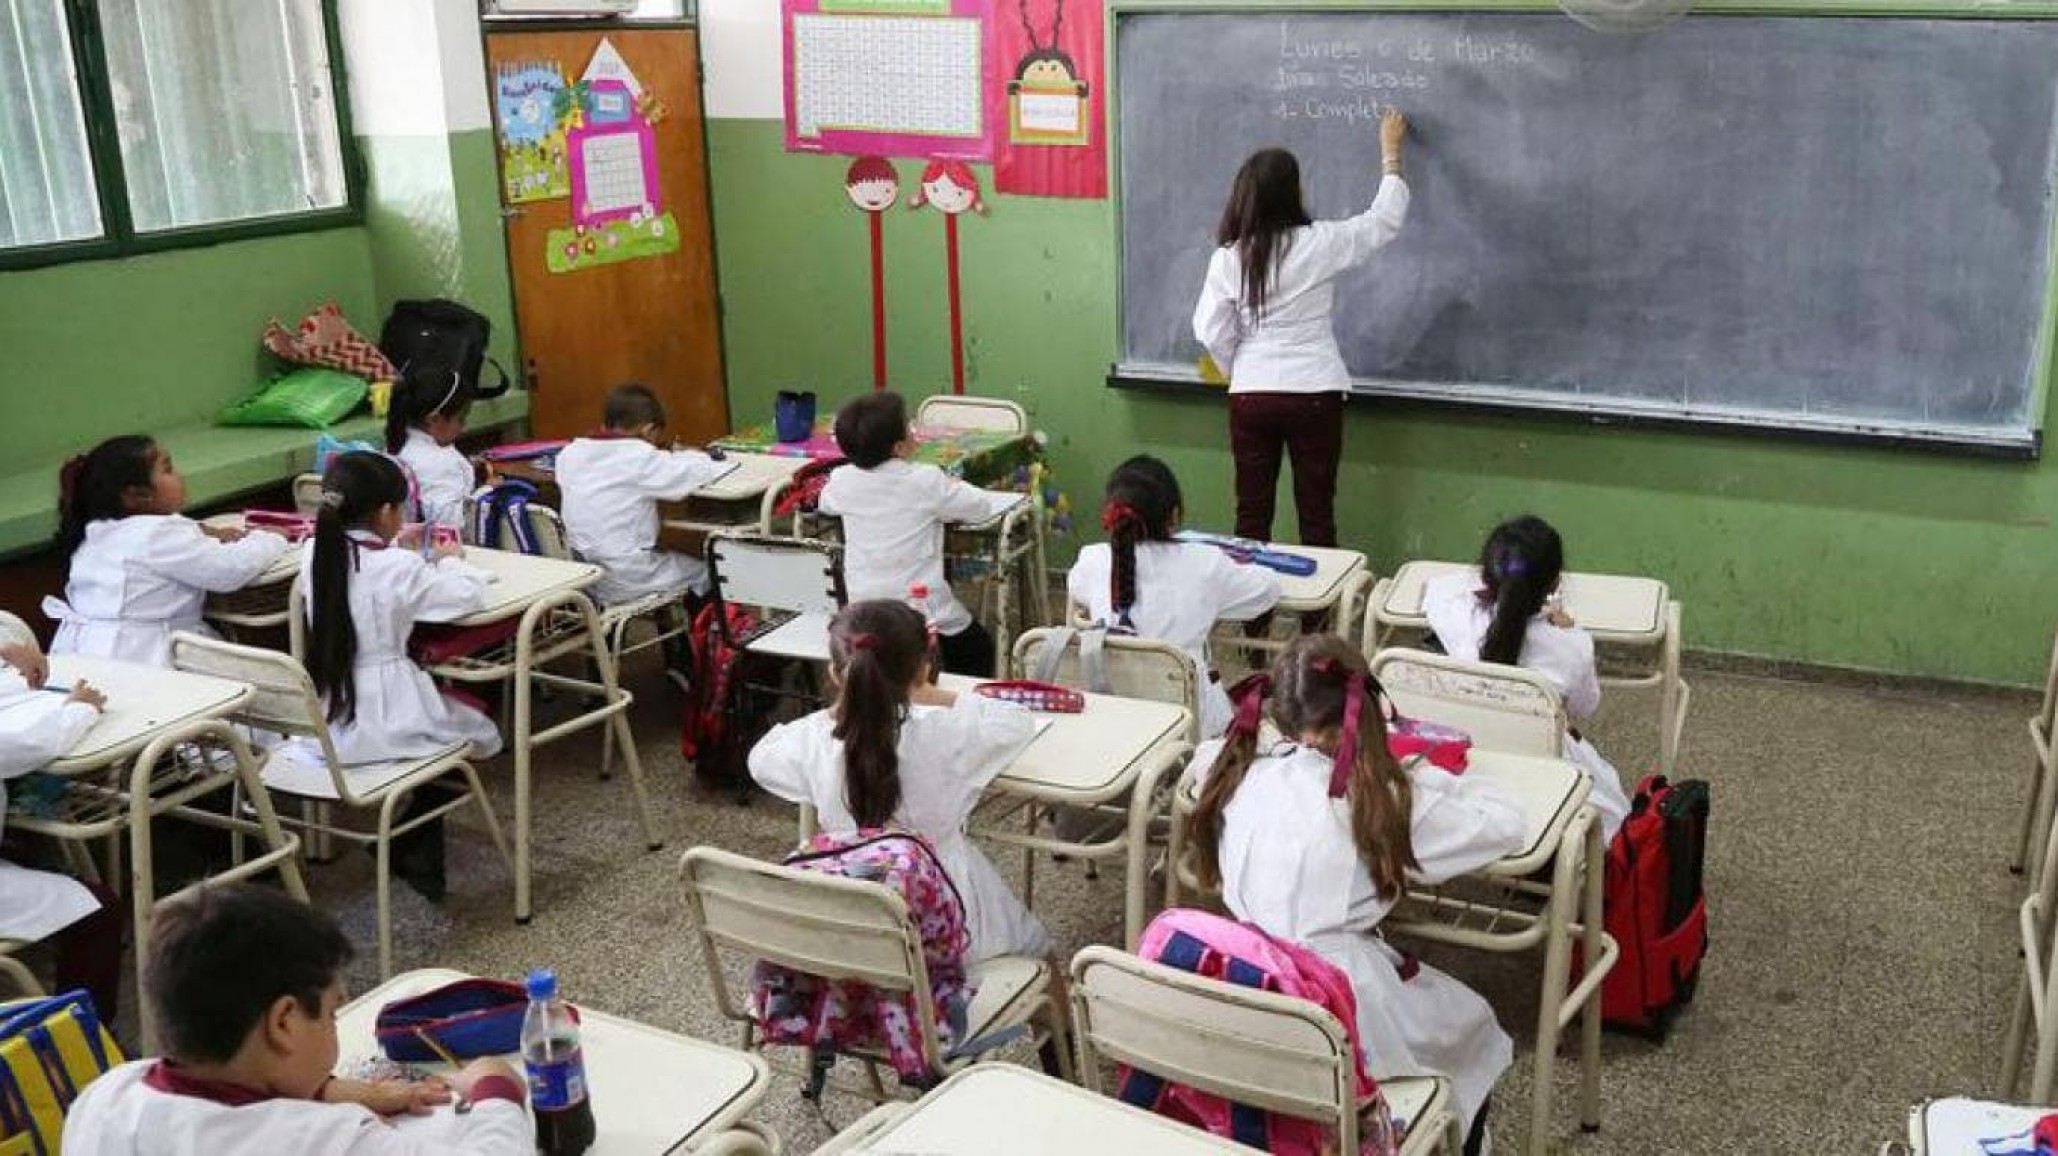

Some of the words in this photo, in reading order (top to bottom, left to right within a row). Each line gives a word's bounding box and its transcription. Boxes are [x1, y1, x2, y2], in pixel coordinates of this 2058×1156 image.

[1279, 22, 1361, 58] Lunes
[1408, 38, 1436, 62] de
[1455, 34, 1536, 63] Marzo
